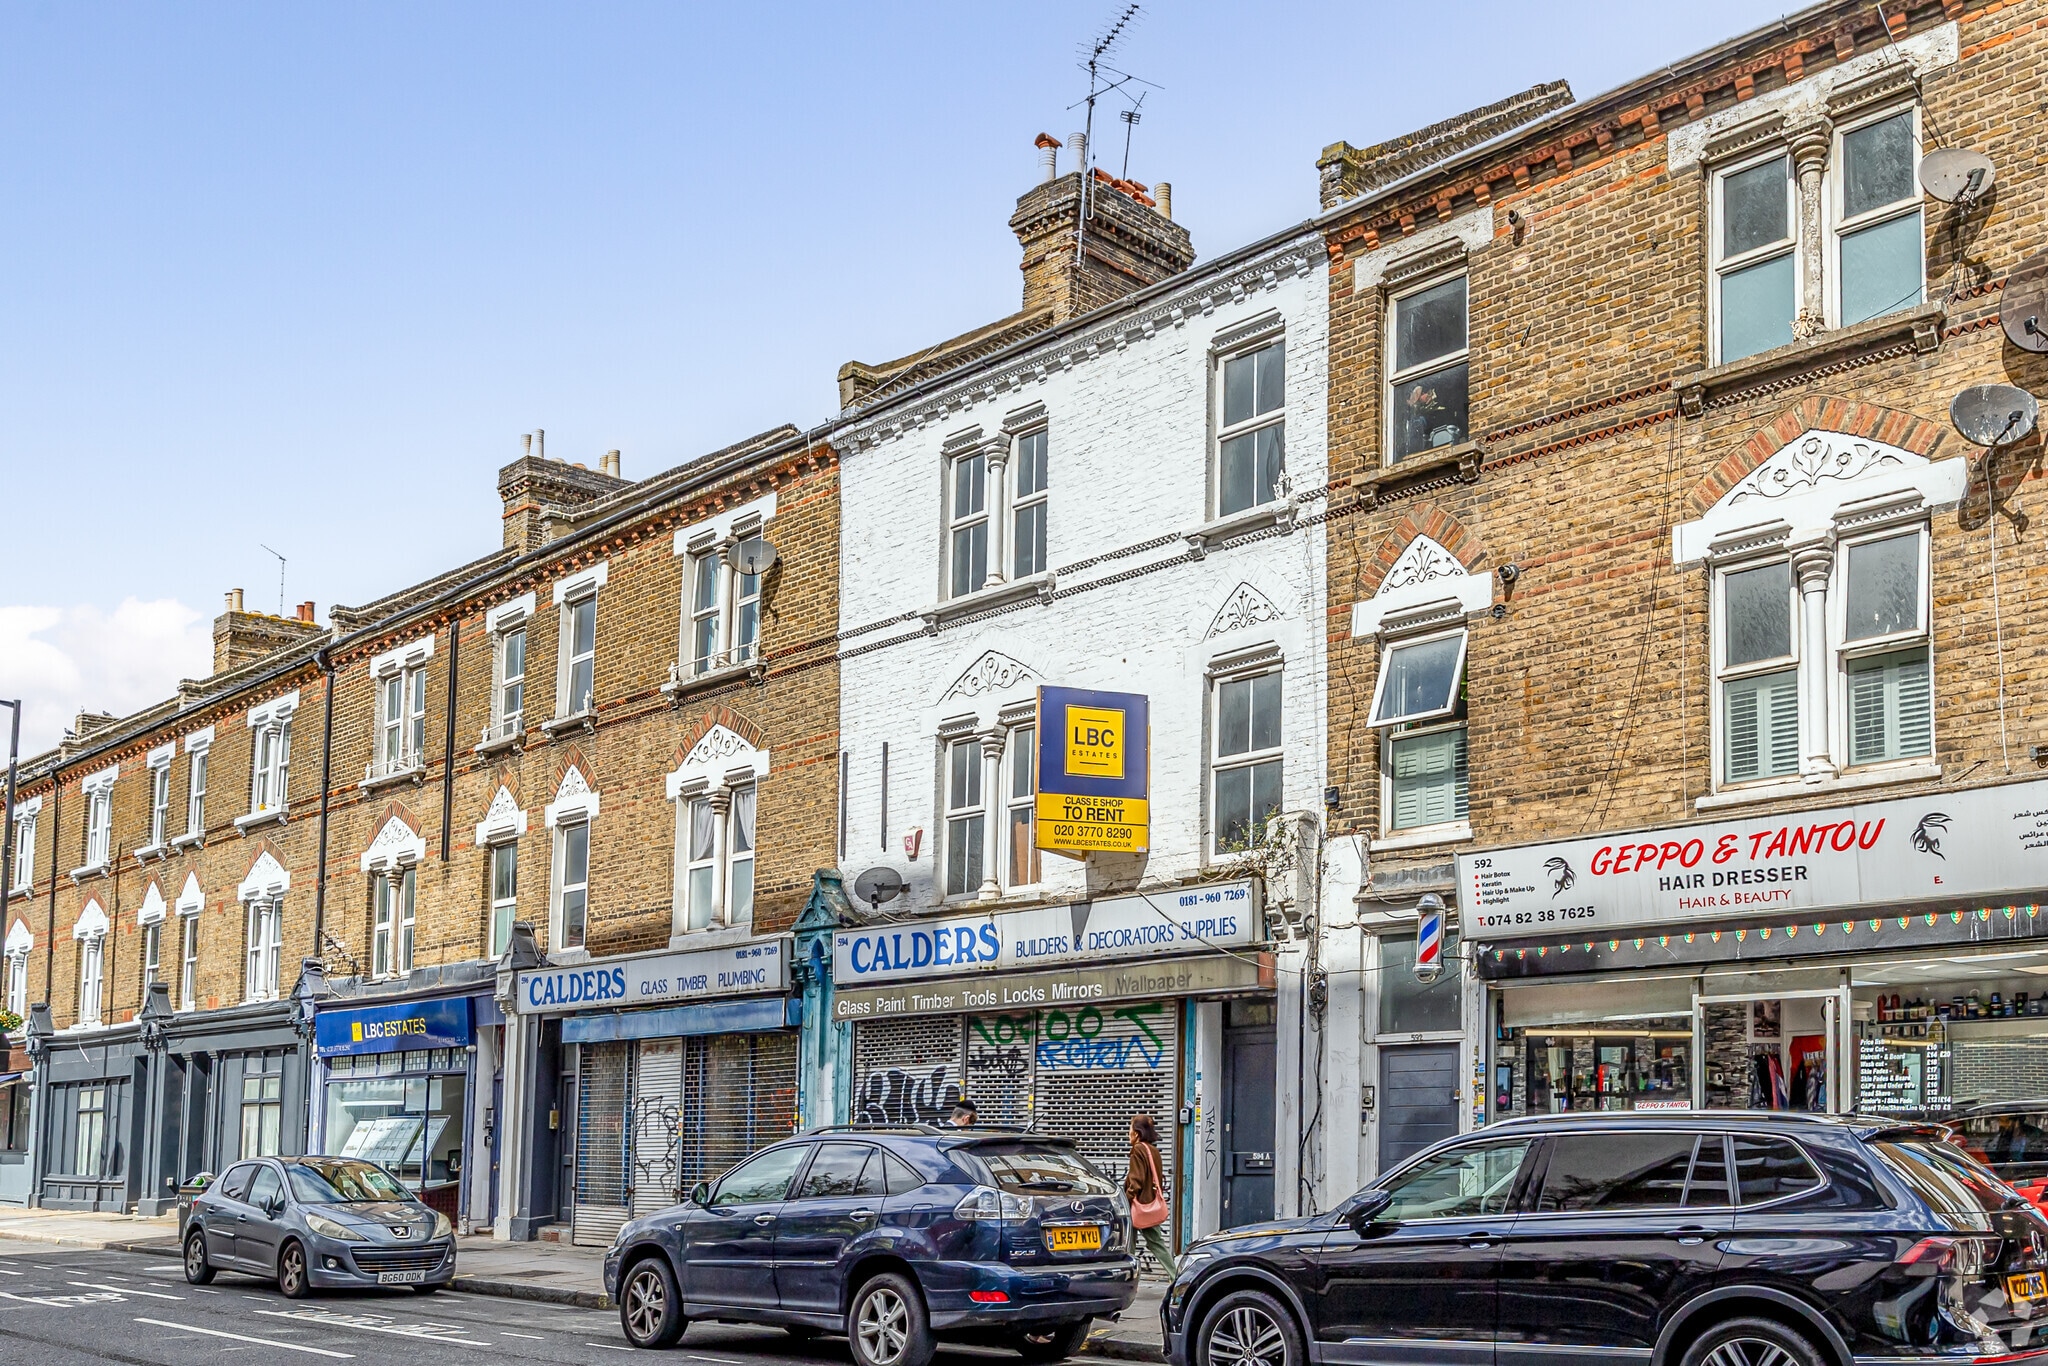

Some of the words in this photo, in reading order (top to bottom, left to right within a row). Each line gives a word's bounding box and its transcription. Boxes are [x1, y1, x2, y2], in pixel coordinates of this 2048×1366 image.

[1074, 726, 1115, 748] LBC
[1072, 750, 1118, 759] ESTATES
[1065, 796, 1091, 806] CLASS
[1093, 798, 1098, 806] E
[1100, 799, 1124, 808] SHOP
[1063, 806, 1082, 820] TO
[1086, 808, 1125, 822] RENT
[1054, 824, 1074, 836] 020
[1078, 826, 1103, 837] 3770
[1106, 827, 1132, 839] 8290
[1054, 838, 1132, 848] WWW.LBCESTATES.CO.UK
[1590, 838, 1704, 876] GEPPO
[1712, 834, 1739, 864] &
[1748, 818, 1886, 861] TANTOU
[1474, 859, 1492, 869] 592
[1482, 880, 1502, 888] Keratin
[1658, 874, 1705, 892] HAIR
[1712, 866, 1808, 887] DRESSER
[1224, 889, 1245, 901] 7269
[1495, 888, 1504, 896] Up
[1510, 886, 1525, 894] Make
[1526, 885, 1535, 893] Up
[1483, 897, 1510, 905] Highlight
[1679, 896, 1716, 910] HAIR
[1720, 894, 1731, 905] &
[1734, 889, 1792, 904] BEAUTY
[1515, 912, 1532, 924] 82
[1538, 910, 1555, 921] 38
[1560, 906, 1595, 920] 7625
[764, 946, 778, 956] 7269
[837, 937, 848, 947] 594
[851, 922, 1000, 974] CALDERS
[1016, 936, 1068, 958] BUILDERS
[1074, 935, 1084, 951] &
[1088, 924, 1174, 950] DECORATORS
[1180, 916, 1237, 940] SUPPLIES
[529, 967, 626, 1006] CALDERS
[640, 979, 667, 996] GLASS
[677, 974, 708, 992] TIMBER
[718, 968, 766, 987] PLUMBING
[837, 1000, 870, 1016] Glass
[876, 996, 906, 1013] Paint
[912, 993, 955, 1010] Timber
[962, 990, 997, 1006] Tools
[1003, 986, 1045, 1004] Locks
[1052, 983, 1102, 1000] Mirrors
[1117, 972, 1192, 995] Wallpaper
[1054, 1231, 1078, 1245] LR57
[1081, 1231, 1098, 1243] WYU
[382, 1273, 404, 1282] BG60
